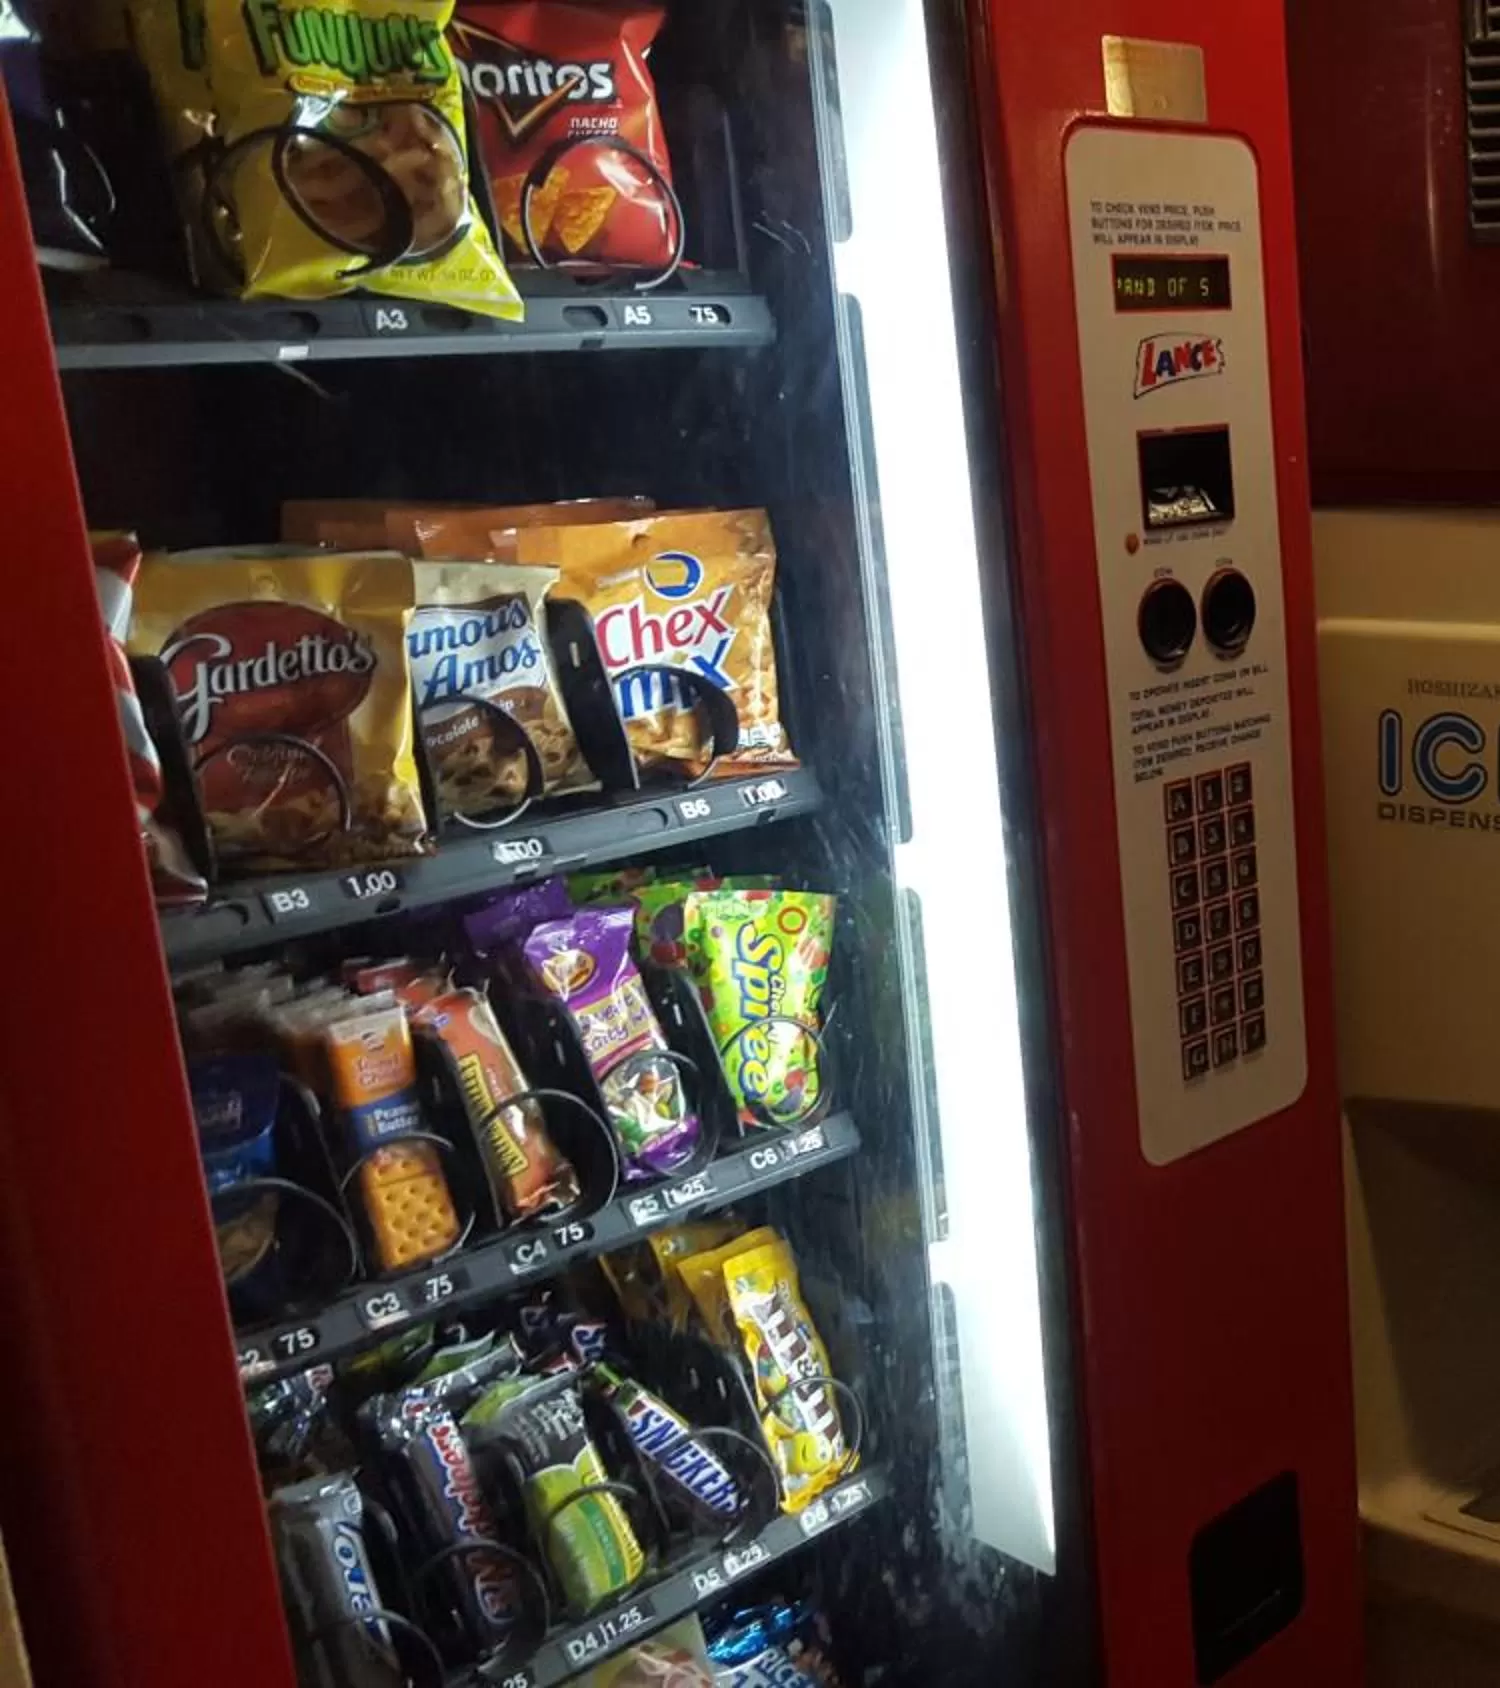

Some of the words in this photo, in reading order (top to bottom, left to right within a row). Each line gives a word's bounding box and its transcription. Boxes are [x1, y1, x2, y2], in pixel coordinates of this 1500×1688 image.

[569, 116, 619, 129] NACHO
[375, 308, 409, 330] A3
[624, 305, 651, 325] A5
[690, 306, 719, 324] 75
[1140, 338, 1218, 388] LANCE
[595, 590, 728, 669] Chex
[159, 631, 378, 743] Gardetto's
[420, 637, 541, 708] Amos
[680, 798, 712, 819] B6
[271, 888, 310, 914] B3
[347, 869, 398, 898] 1.00
[731, 919, 785, 1101] Spree
[750, 1148, 778, 1170] C6
[628, 1194, 659, 1218] C5
[668, 1180, 707, 1205] 1.25
[516, 1239, 548, 1262] C4
[555, 1223, 585, 1245] 75
[364, 1291, 401, 1319] C3
[279, 1327, 317, 1355] 75
[630, 1409, 740, 1515] SNCKER
[800, 1500, 829, 1531] D6
[693, 1566, 721, 1595] D5
[567, 1631, 598, 1662] D4
[606, 1606, 642, 1637] 1.25
[756, 1647, 809, 1688] RICE
